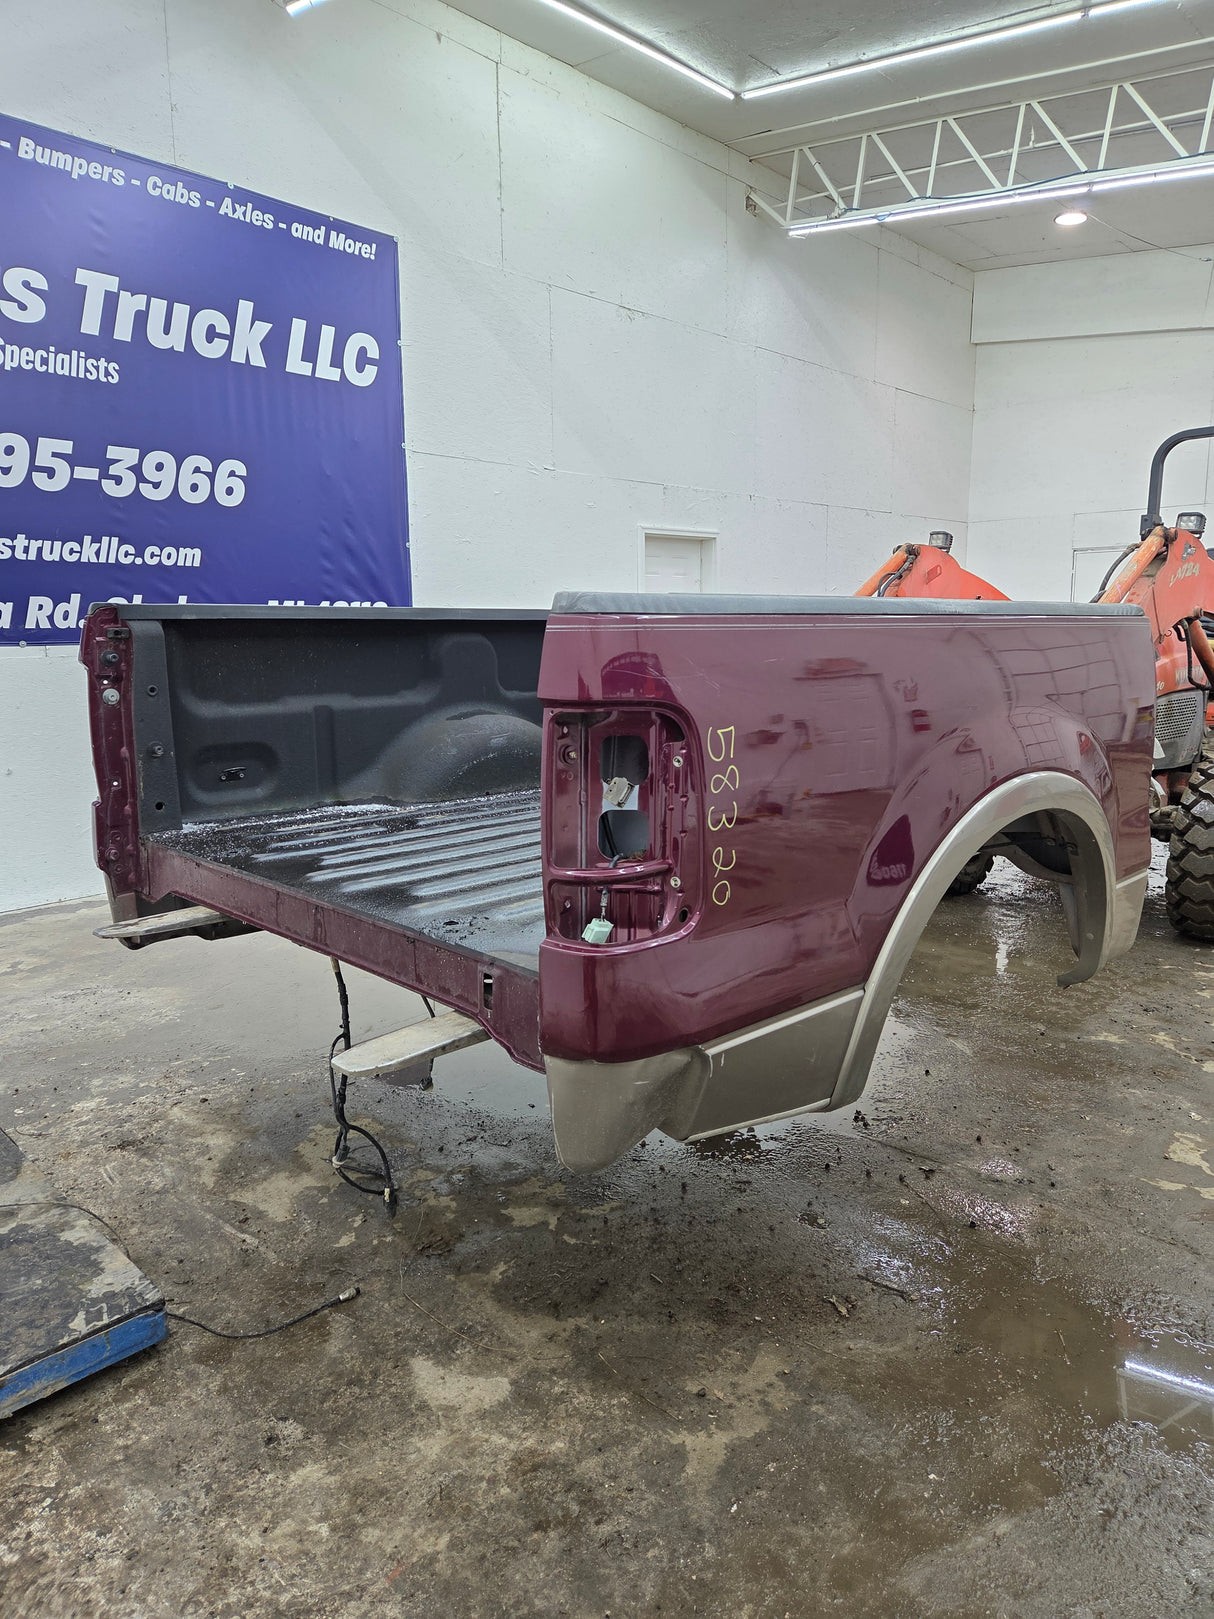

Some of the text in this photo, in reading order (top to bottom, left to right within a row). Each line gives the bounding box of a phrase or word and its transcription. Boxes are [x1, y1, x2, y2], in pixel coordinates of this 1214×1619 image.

[17, 136, 126, 186] Bumpers
[146, 175, 201, 208] Cabs
[218, 196, 275, 230] Axles
[291, 221, 326, 245] and
[328, 230, 377, 260] More!
[74, 267, 274, 369] Truck
[285, 317, 381, 388] LLC
[0, 432, 248, 507] 95-3966
[0, 534, 202, 567] struckllc.com
